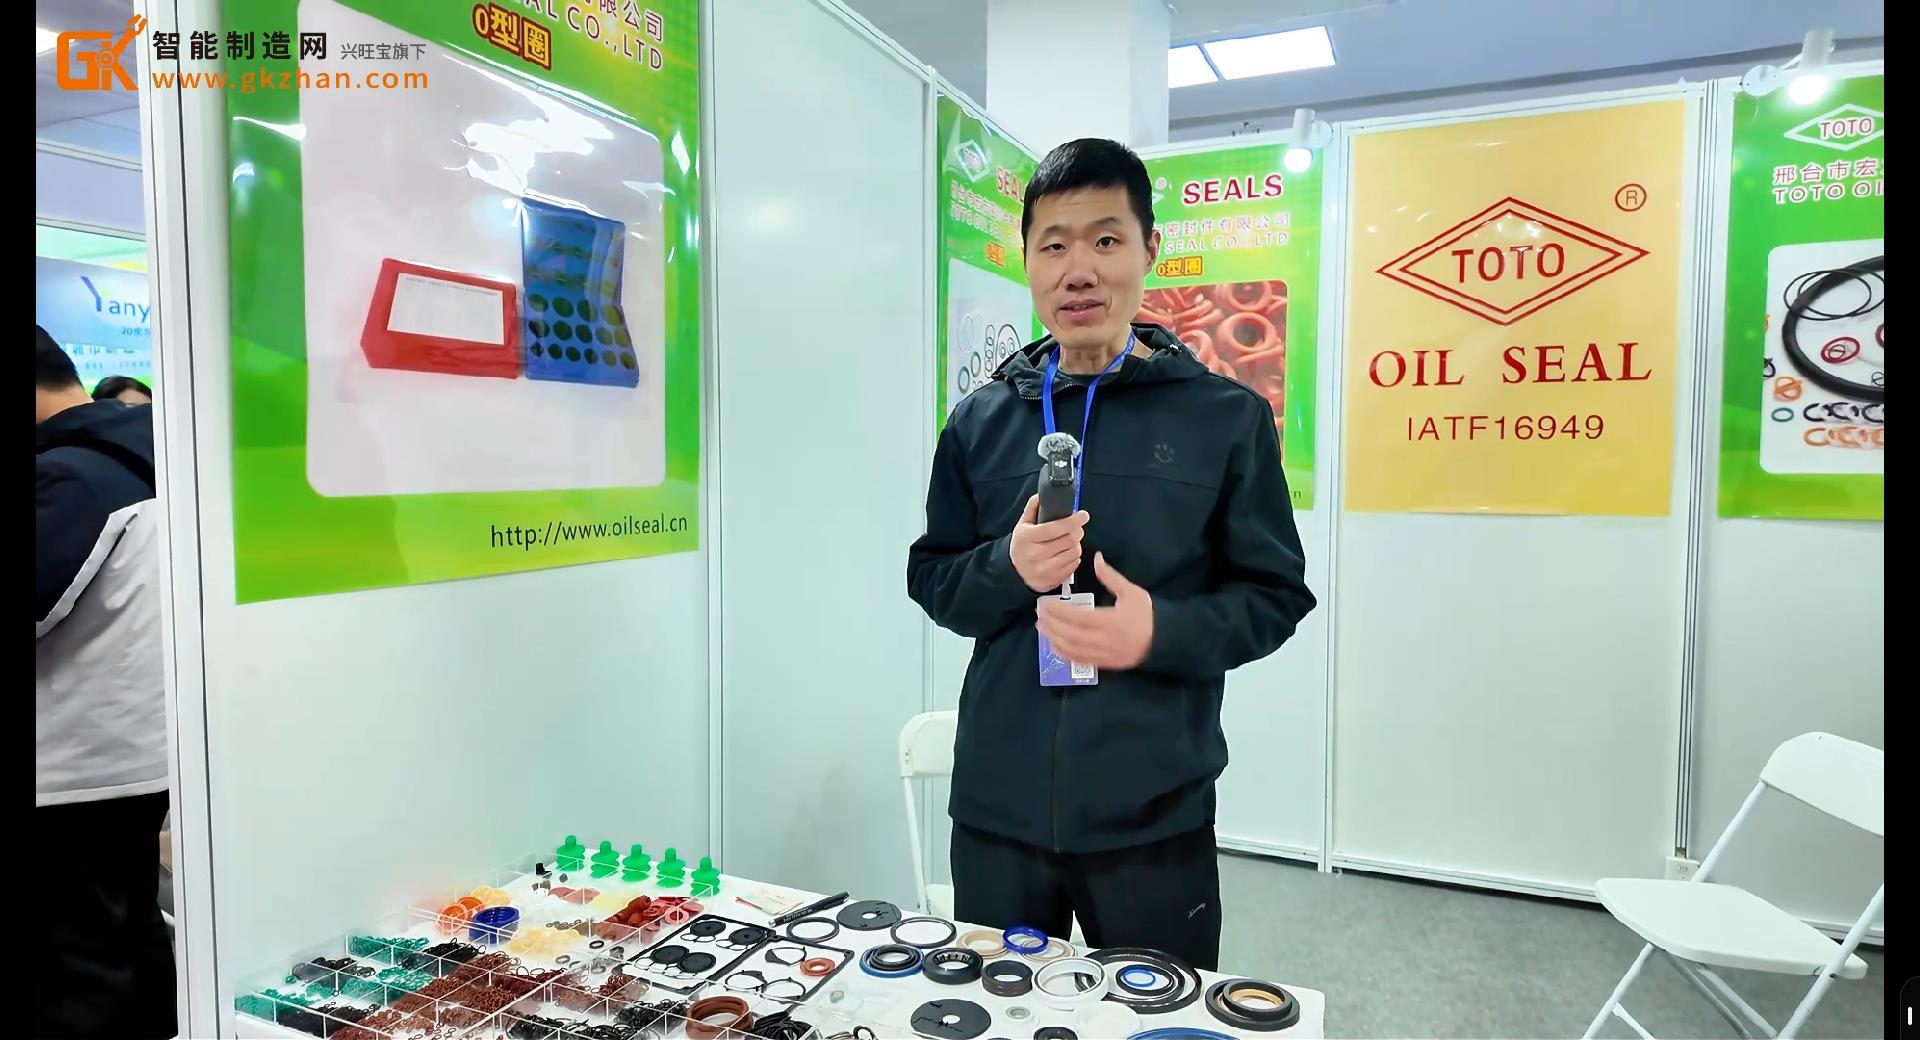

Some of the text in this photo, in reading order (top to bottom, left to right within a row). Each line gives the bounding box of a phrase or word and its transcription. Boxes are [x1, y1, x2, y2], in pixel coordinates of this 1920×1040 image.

[568, 6, 662, 69] CO.,LTD
[1820, 117, 1873, 138] TOTO
[1183, 174, 1283, 205] SEALS
[1774, 185, 1844, 202] TOTO
[1165, 239, 1207, 254] SEAL
[1451, 243, 1565, 283] TOTO
[1368, 342, 1652, 387] OIL SEAL
[1408, 414, 1604, 440] IATF16949
[490, 513, 688, 551] http://www.oilseal.cn
